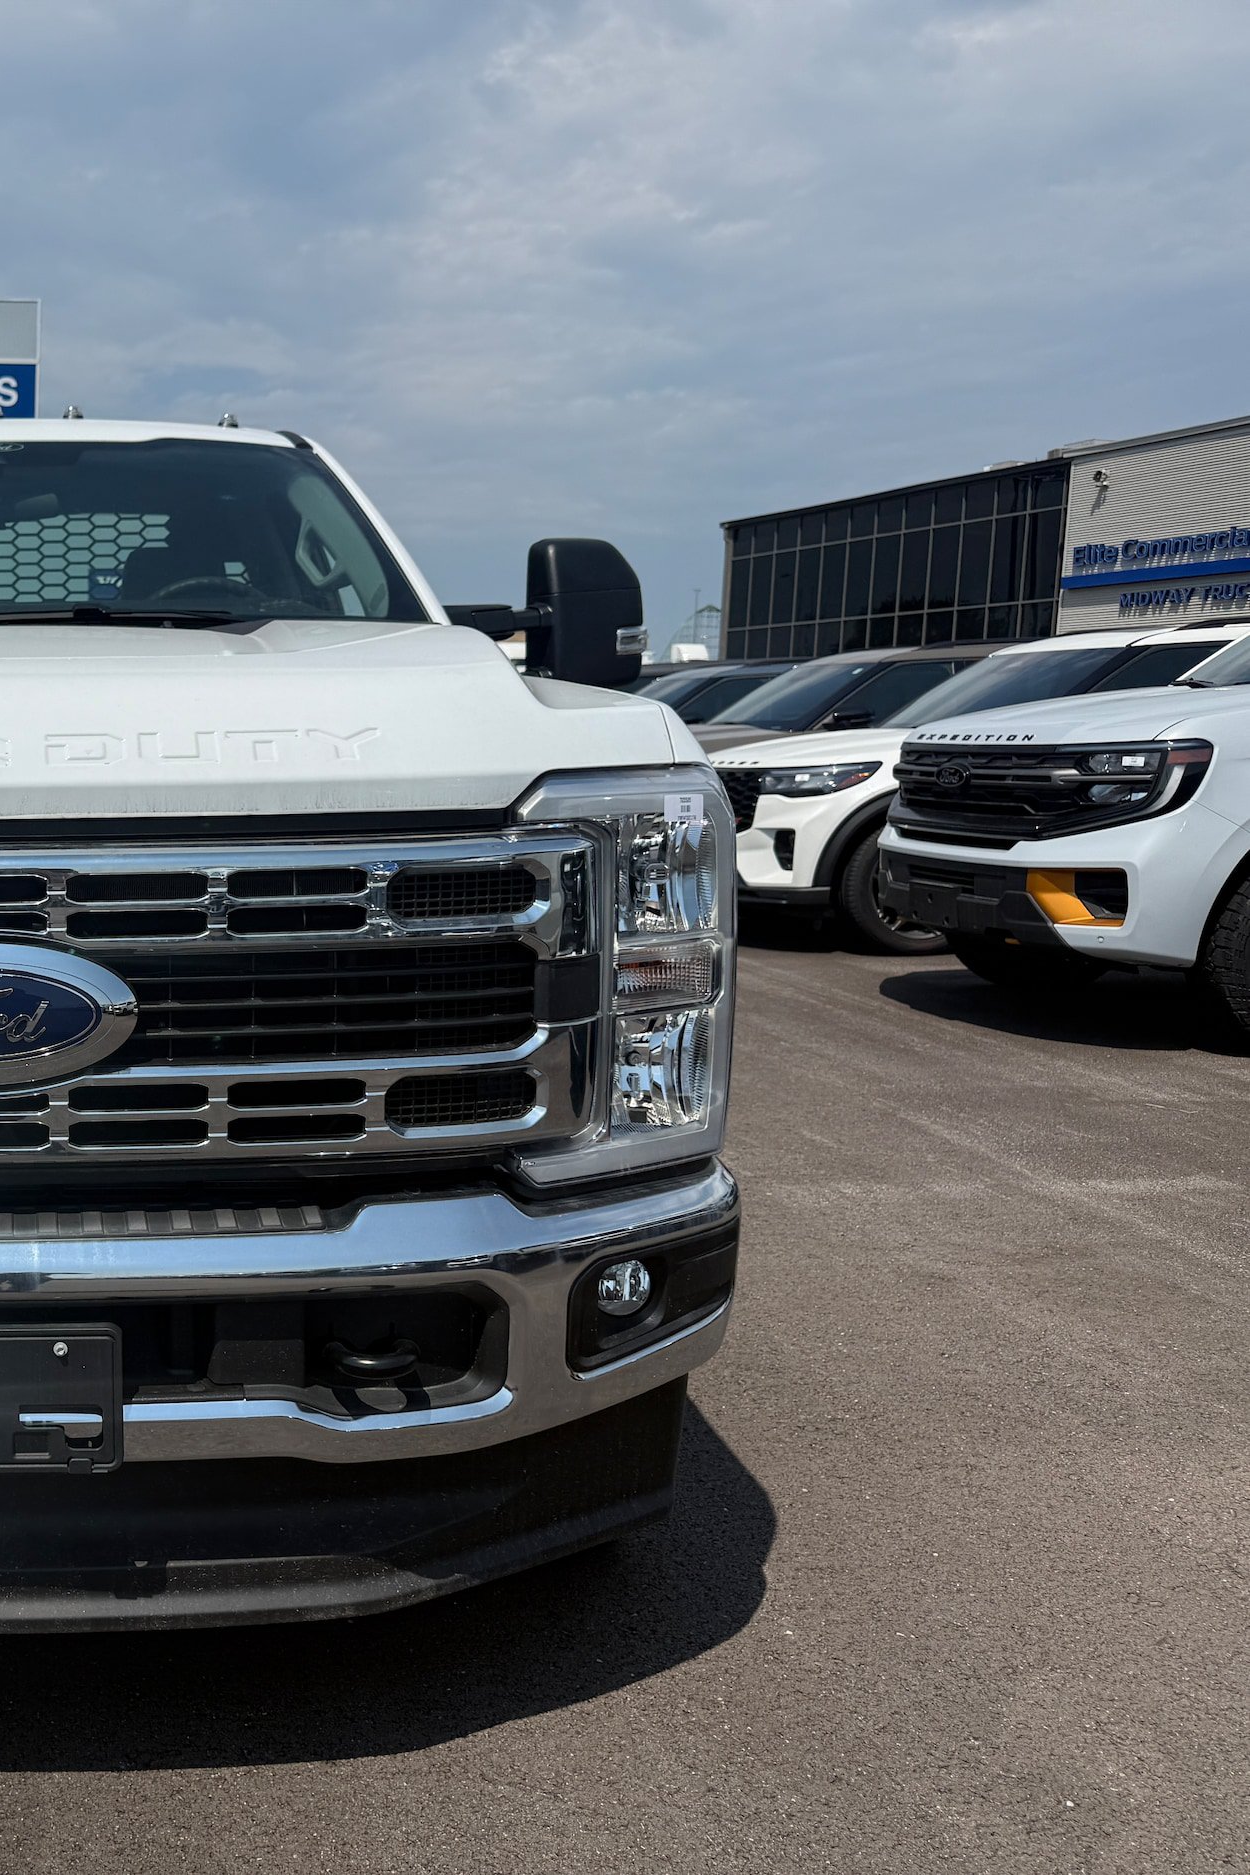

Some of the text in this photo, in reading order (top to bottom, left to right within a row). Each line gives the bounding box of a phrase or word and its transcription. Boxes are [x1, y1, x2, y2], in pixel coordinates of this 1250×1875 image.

[1073, 543, 1119, 567] Elite
[1119, 587, 1195, 608] MIDWAY
[44, 727, 382, 766] DUTY
[916, 733, 1036, 741] EXPEDITION
